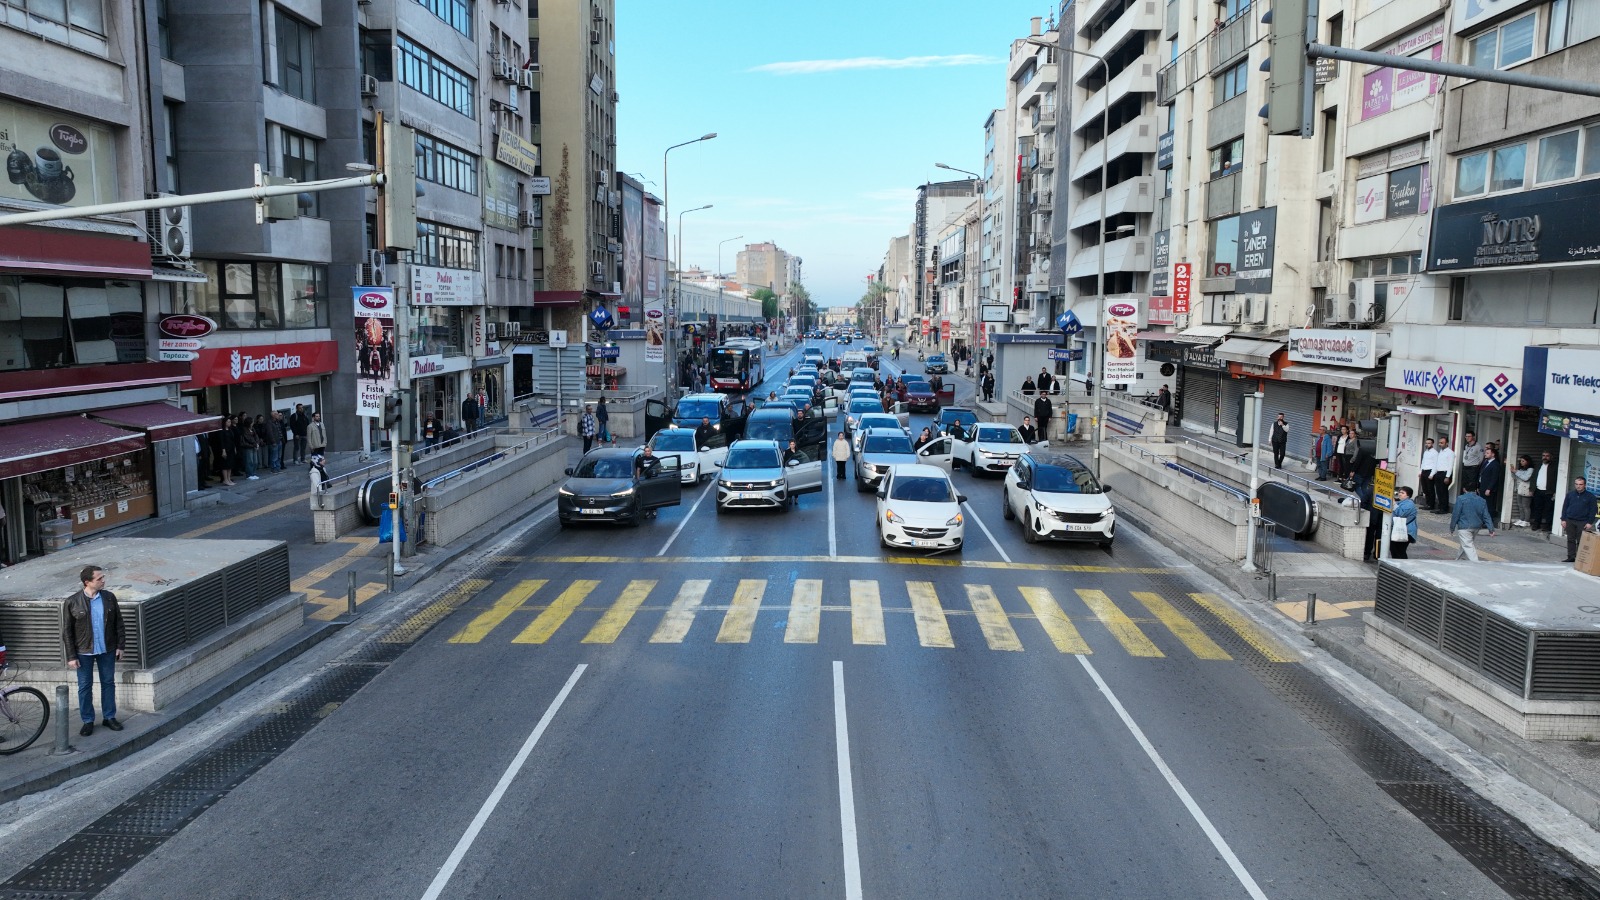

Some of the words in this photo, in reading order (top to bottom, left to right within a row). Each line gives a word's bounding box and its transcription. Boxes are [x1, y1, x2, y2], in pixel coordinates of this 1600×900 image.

[1244, 236, 1267, 252] TANER
[1244, 252, 1265, 268] EREN
[1176, 280, 1188, 312] NOTER
[594, 310, 606, 318] M
[1060, 314, 1071, 322] M
[162, 340, 174, 348] Her
[163, 352, 189, 360] Taptaze
[242, 355, 270, 374] Ziraat
[269, 352, 301, 371] Bankası
[1403, 369, 1431, 387] VAKIF
[1449, 374, 1476, 393] KATI
[1552, 372, 1571, 385] Türk
[1329, 386, 1339, 431] OPTAN
